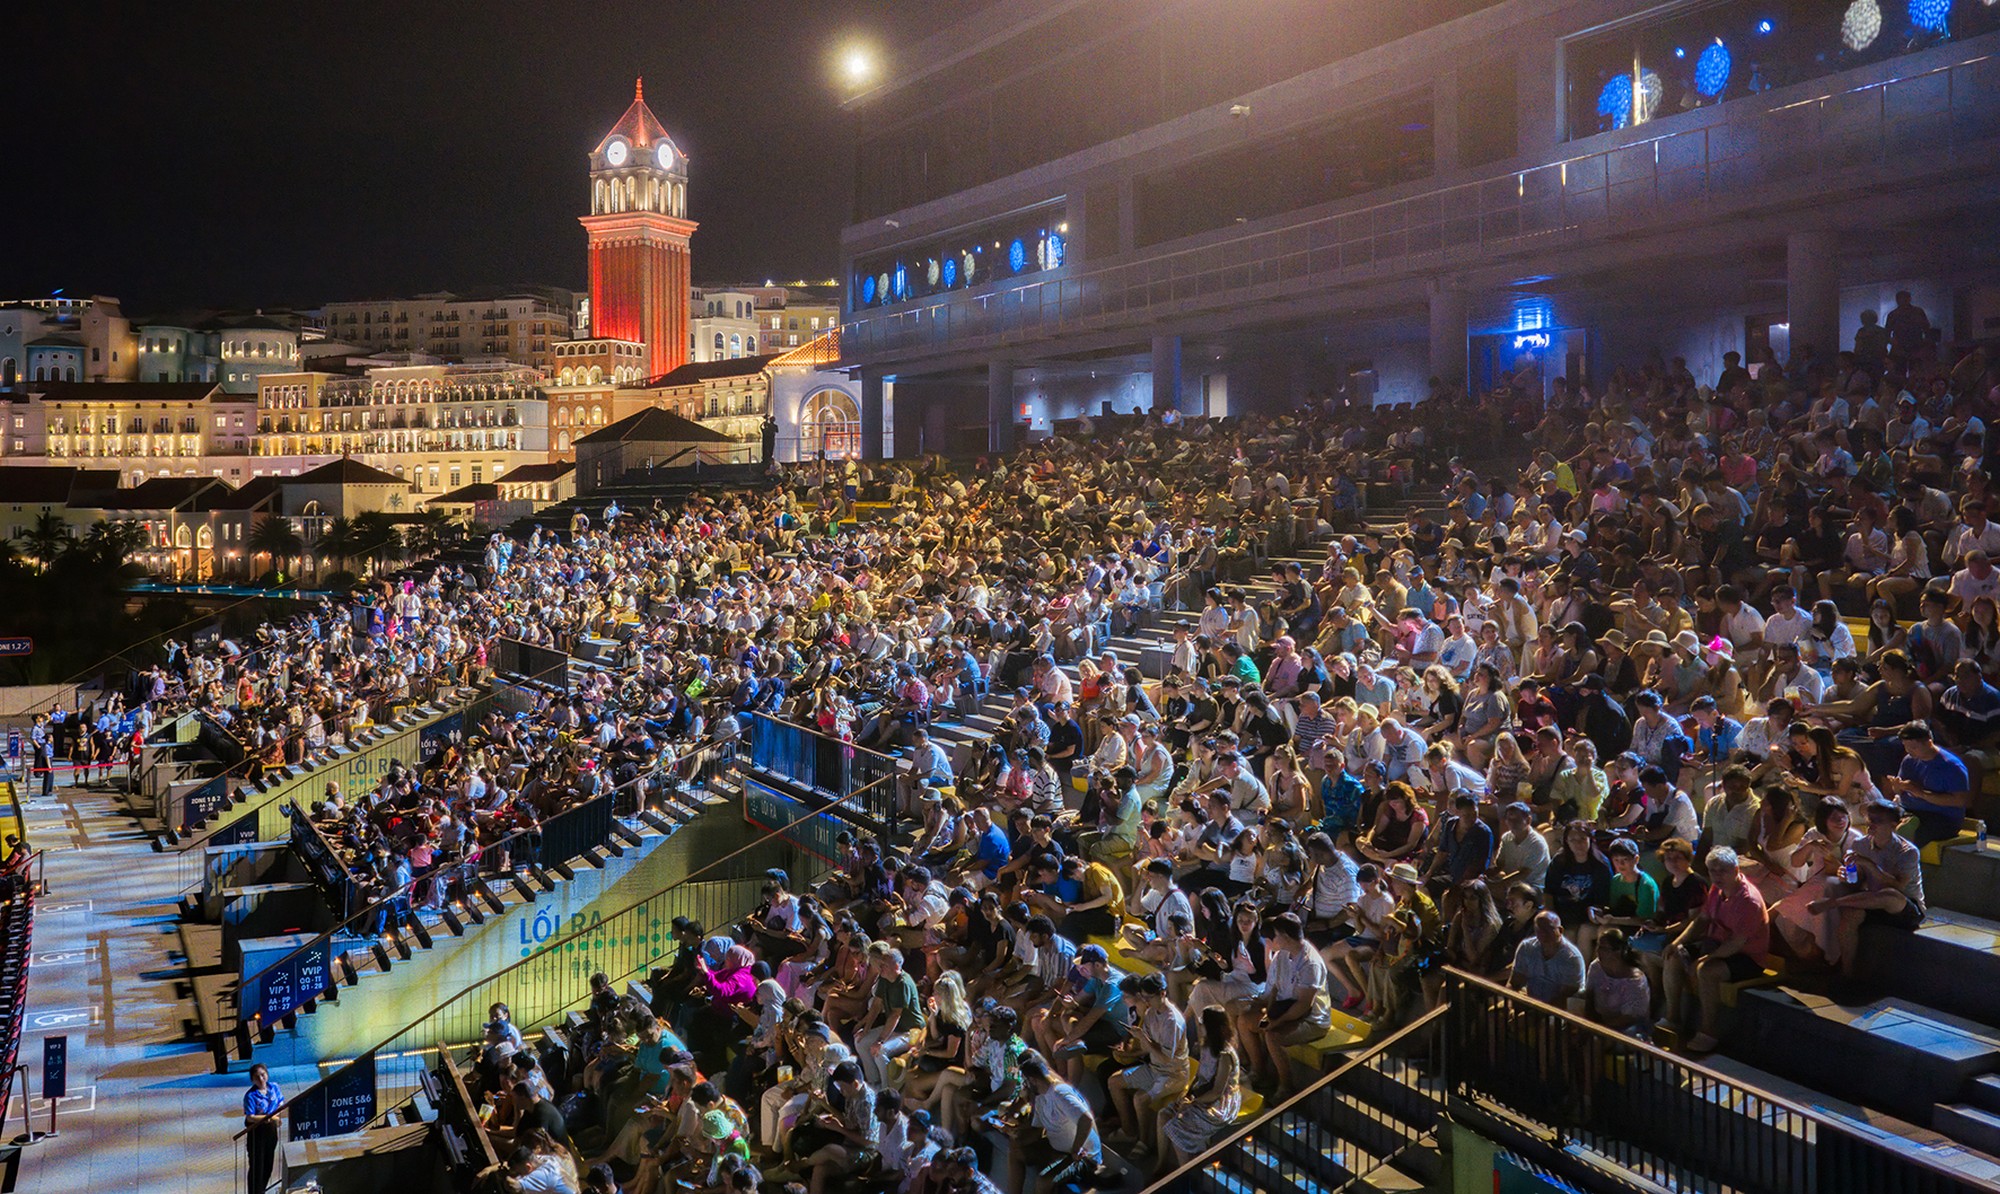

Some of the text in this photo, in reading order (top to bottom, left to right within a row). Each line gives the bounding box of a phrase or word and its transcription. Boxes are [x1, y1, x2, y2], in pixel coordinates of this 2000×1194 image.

[520, 904, 604, 944] LỐI RA
[302, 966, 322, 976] VVIP
[269, 987, 284, 995] VIP
[332, 1094, 372, 1108] ZONE 5&6
[338, 1110, 350, 1118] AA
[297, 1122, 311, 1131] VIP
[338, 1119, 348, 1127] 01
[355, 1116, 366, 1125] 30
